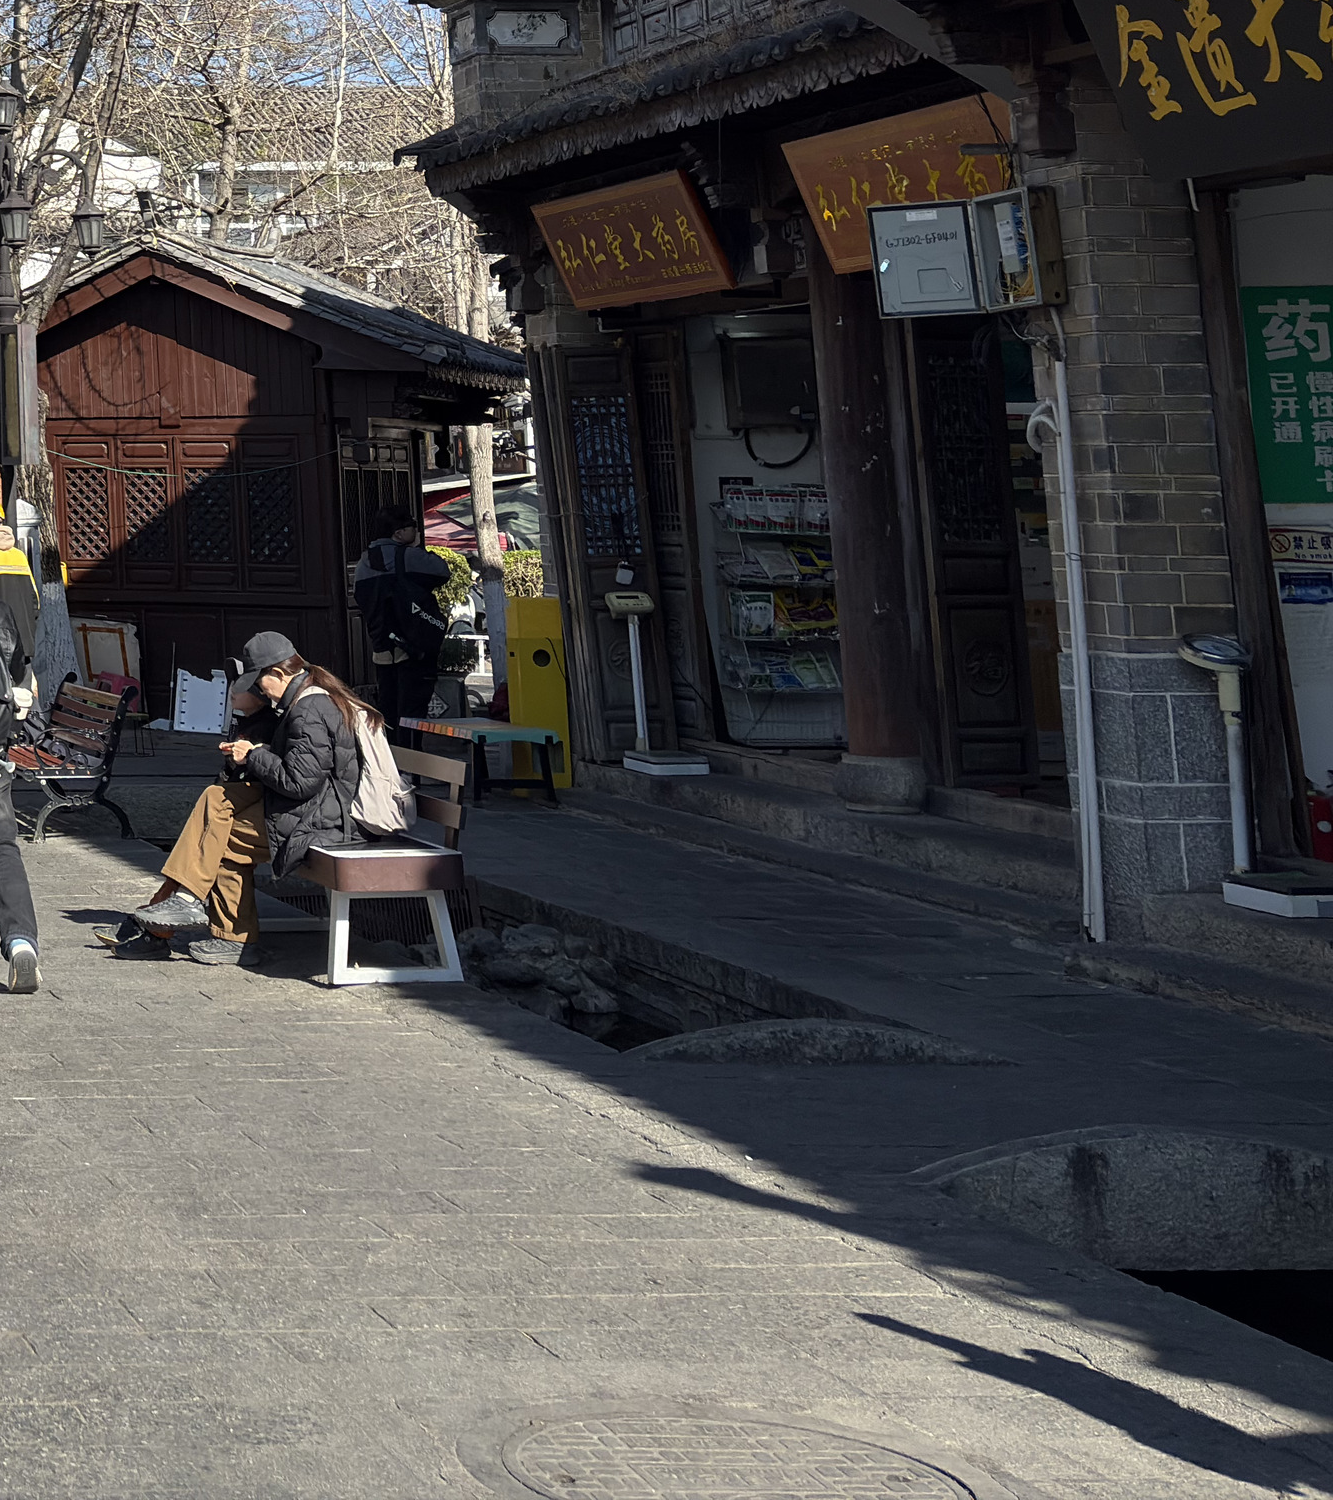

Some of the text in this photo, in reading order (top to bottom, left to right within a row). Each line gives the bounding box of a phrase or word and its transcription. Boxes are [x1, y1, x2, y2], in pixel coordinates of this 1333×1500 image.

[556, 208, 701, 277] 弘仁堂大药房
[1258, 298, 1332, 362] 药
[1269, 372, 1303, 443] 已开通
